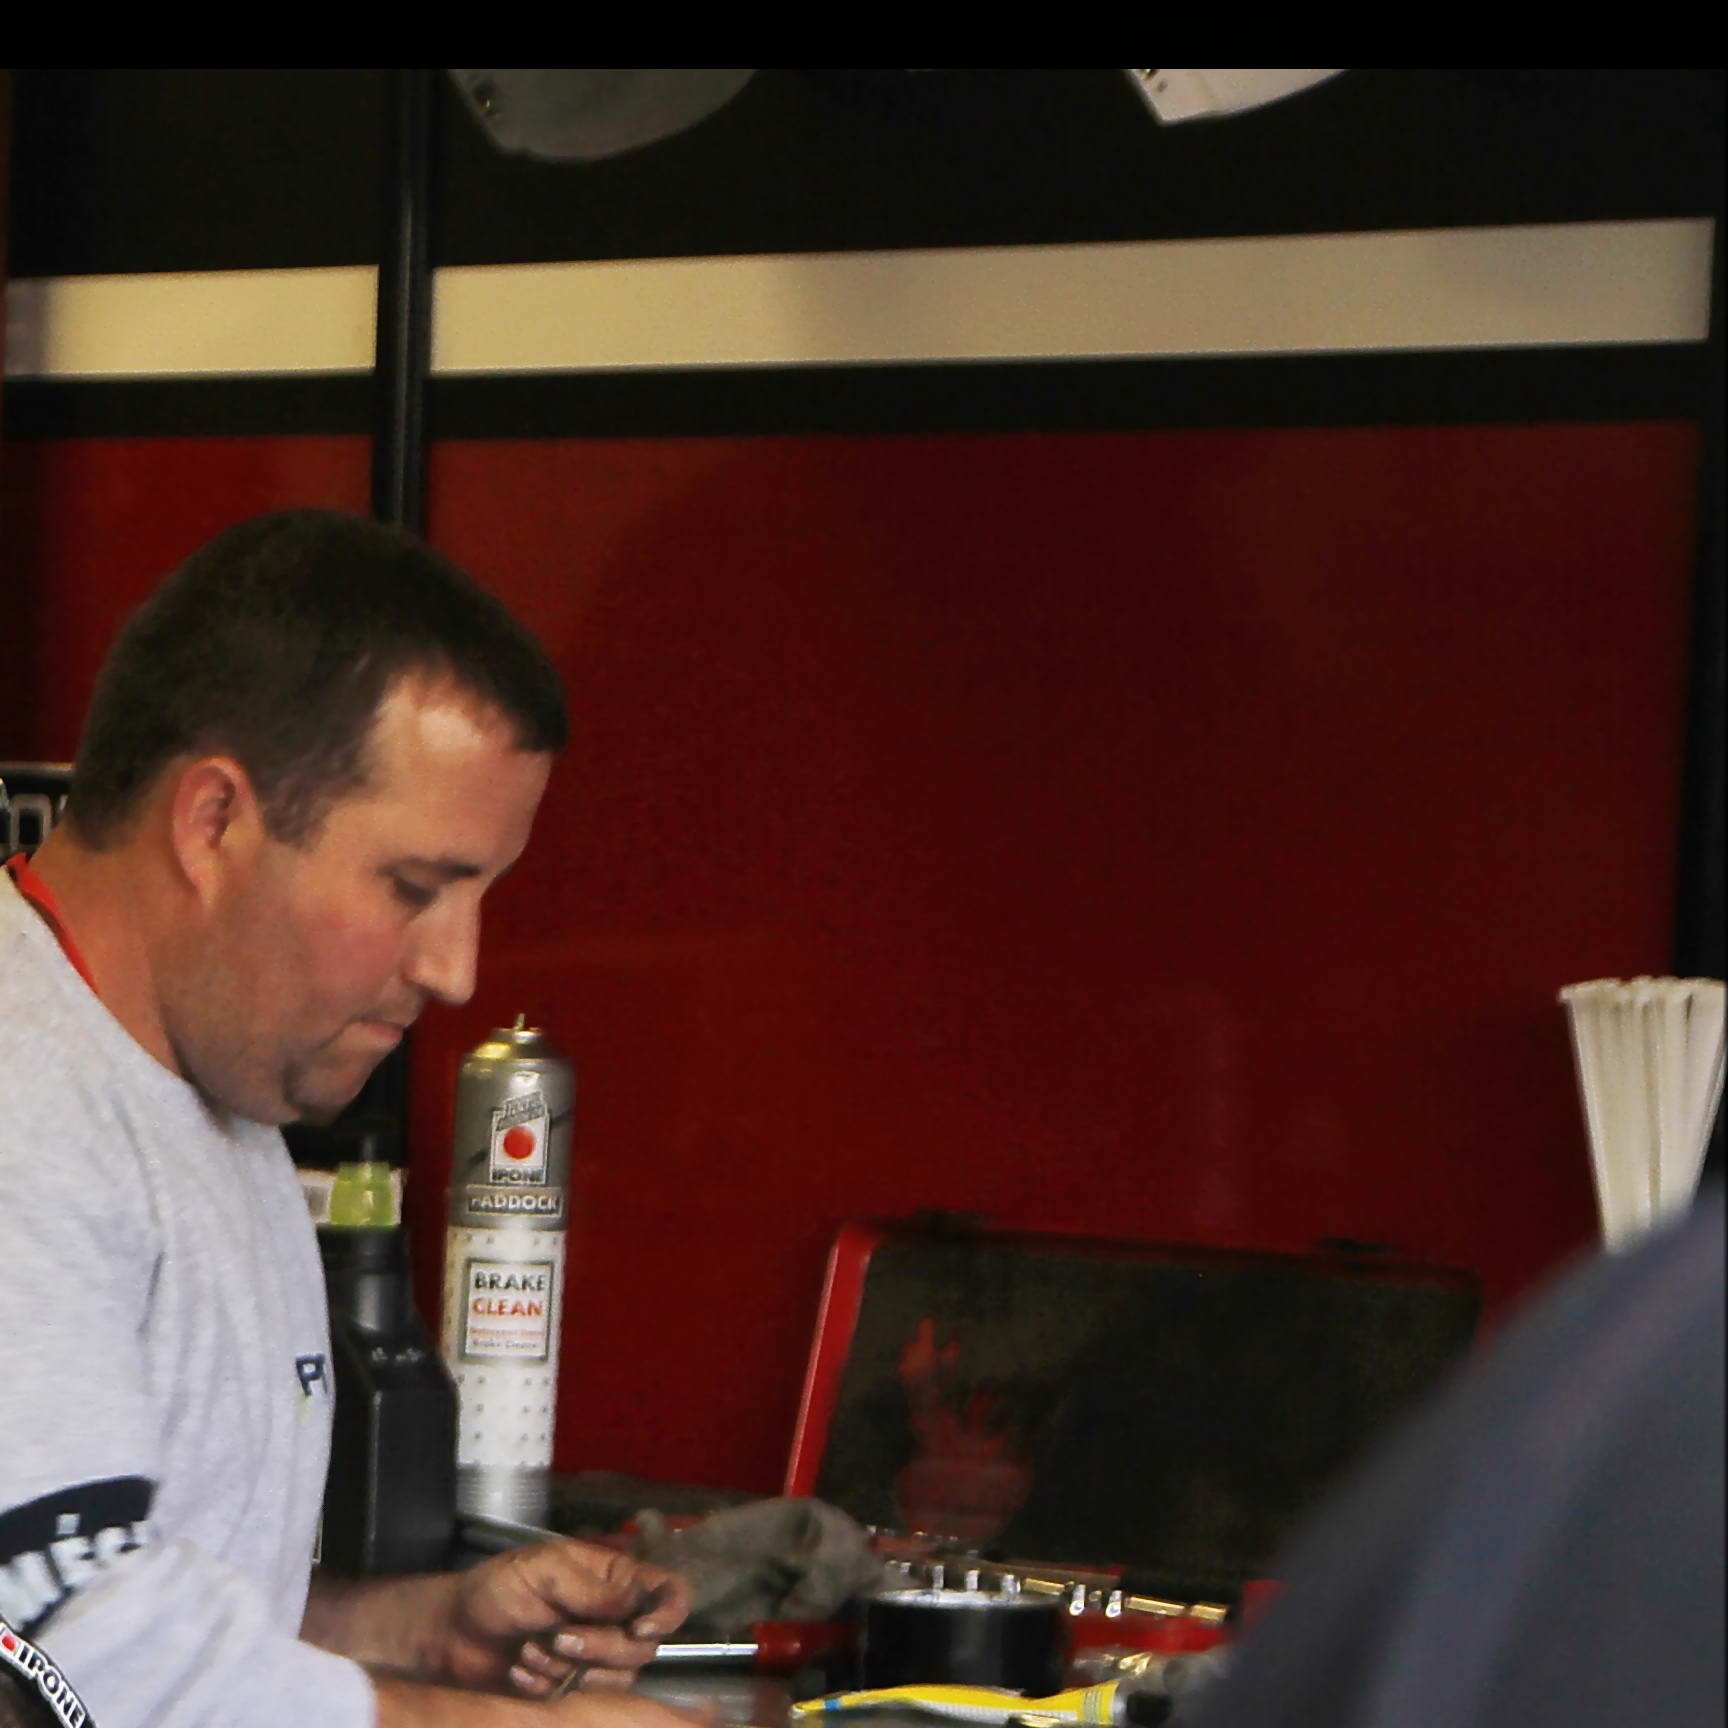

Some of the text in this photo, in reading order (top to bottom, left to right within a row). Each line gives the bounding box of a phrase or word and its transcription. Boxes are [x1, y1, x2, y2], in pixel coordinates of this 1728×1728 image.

[470, 1194, 558, 1211] PADDOCK
[474, 1271, 546, 1291] BRAKE
[472, 1297, 544, 1317] CLEAN
